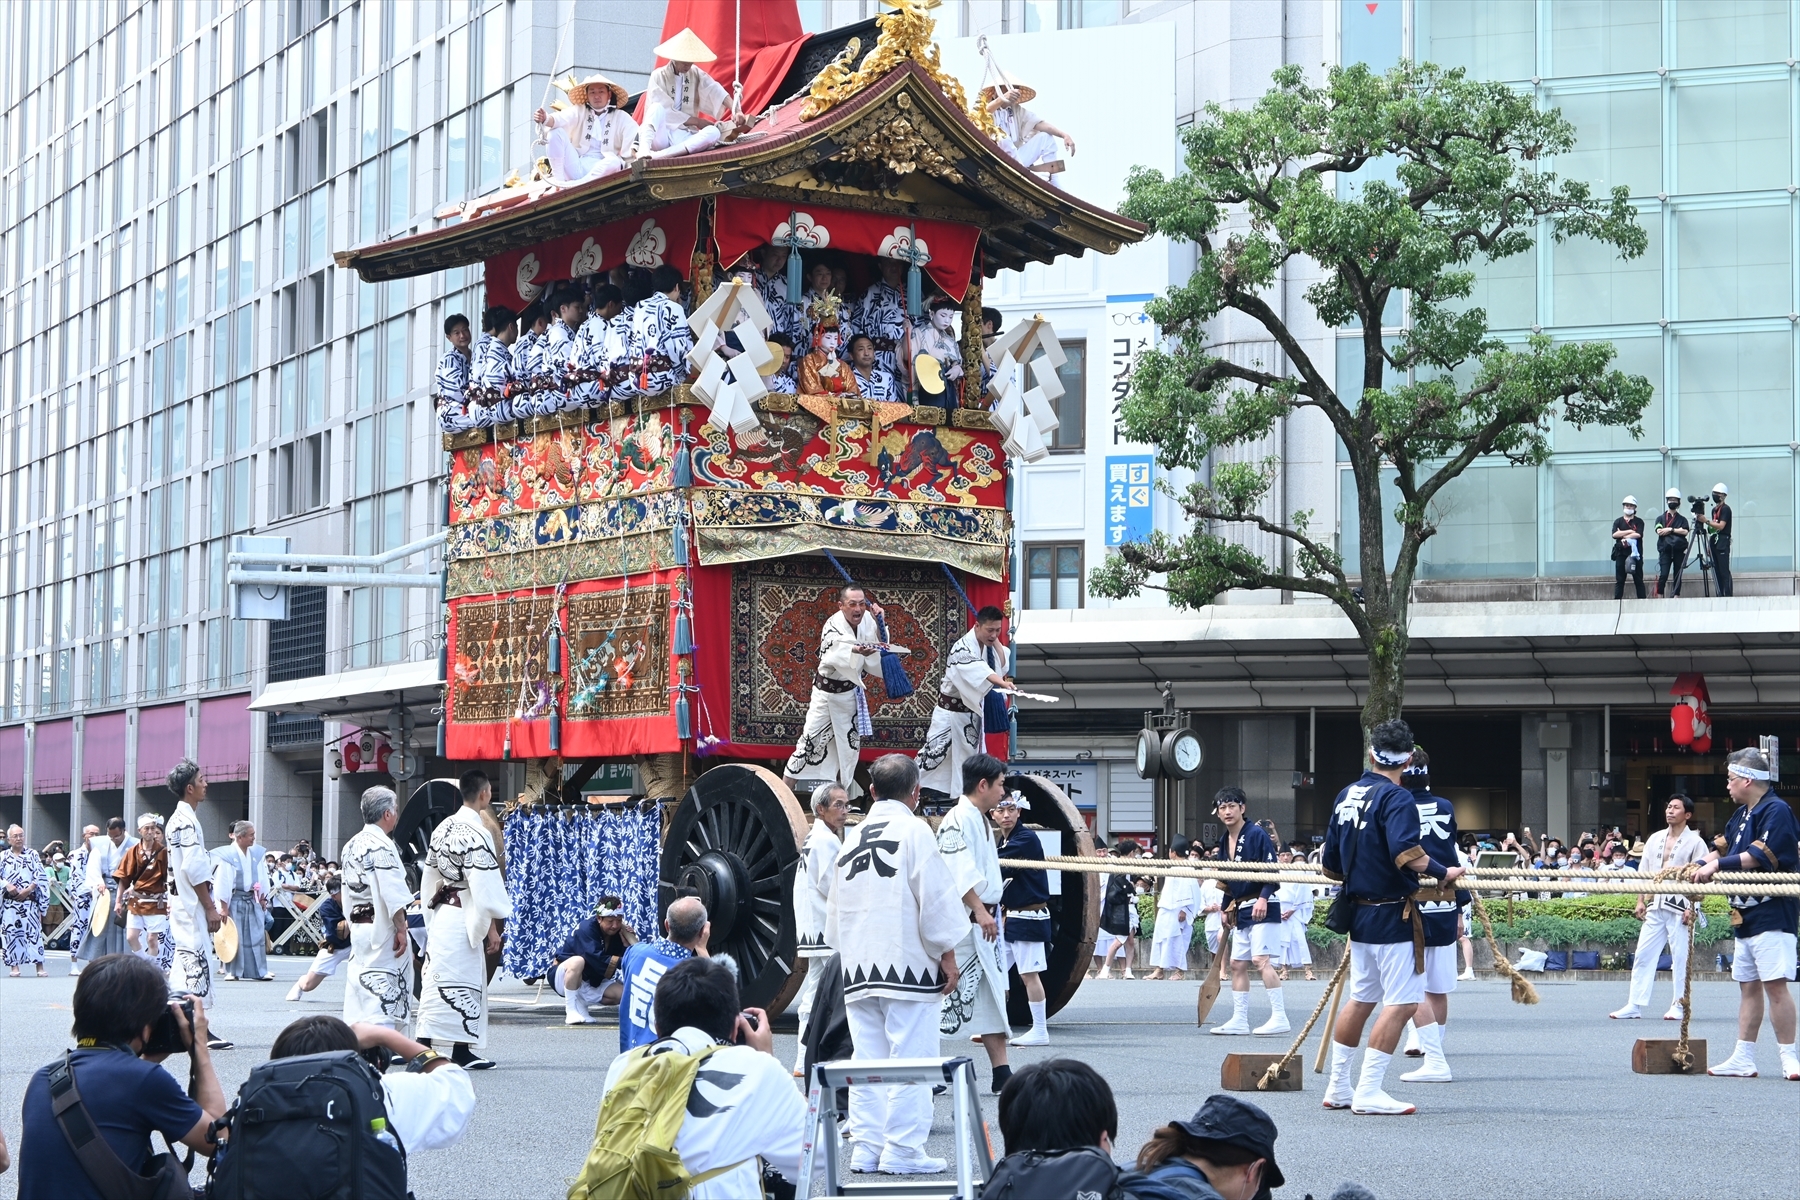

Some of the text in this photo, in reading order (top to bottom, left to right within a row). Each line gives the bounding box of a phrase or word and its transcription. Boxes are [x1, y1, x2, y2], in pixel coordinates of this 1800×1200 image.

[1109, 463, 1128, 543] 買えます
[1131, 465, 1147, 505] すぐ
